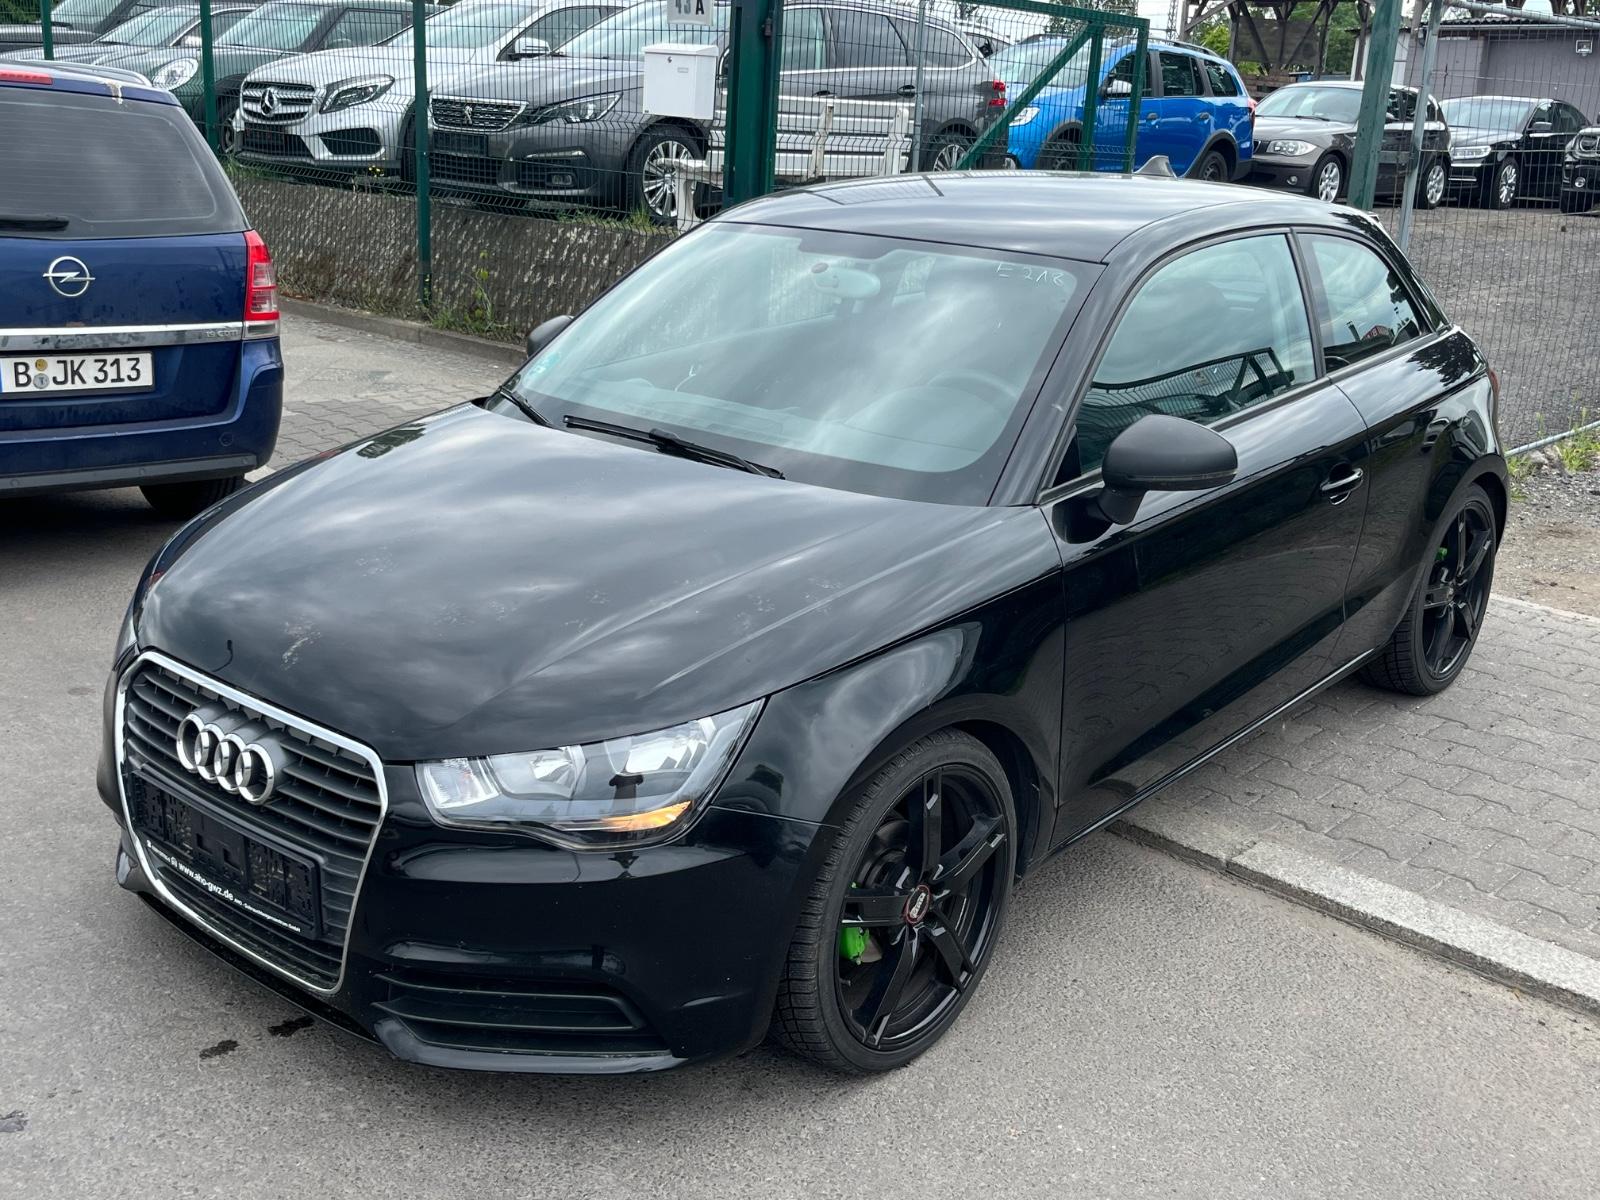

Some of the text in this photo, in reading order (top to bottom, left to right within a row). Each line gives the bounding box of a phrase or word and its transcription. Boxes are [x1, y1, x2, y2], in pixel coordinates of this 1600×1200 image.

[14, 357, 141, 387] B JK 313
